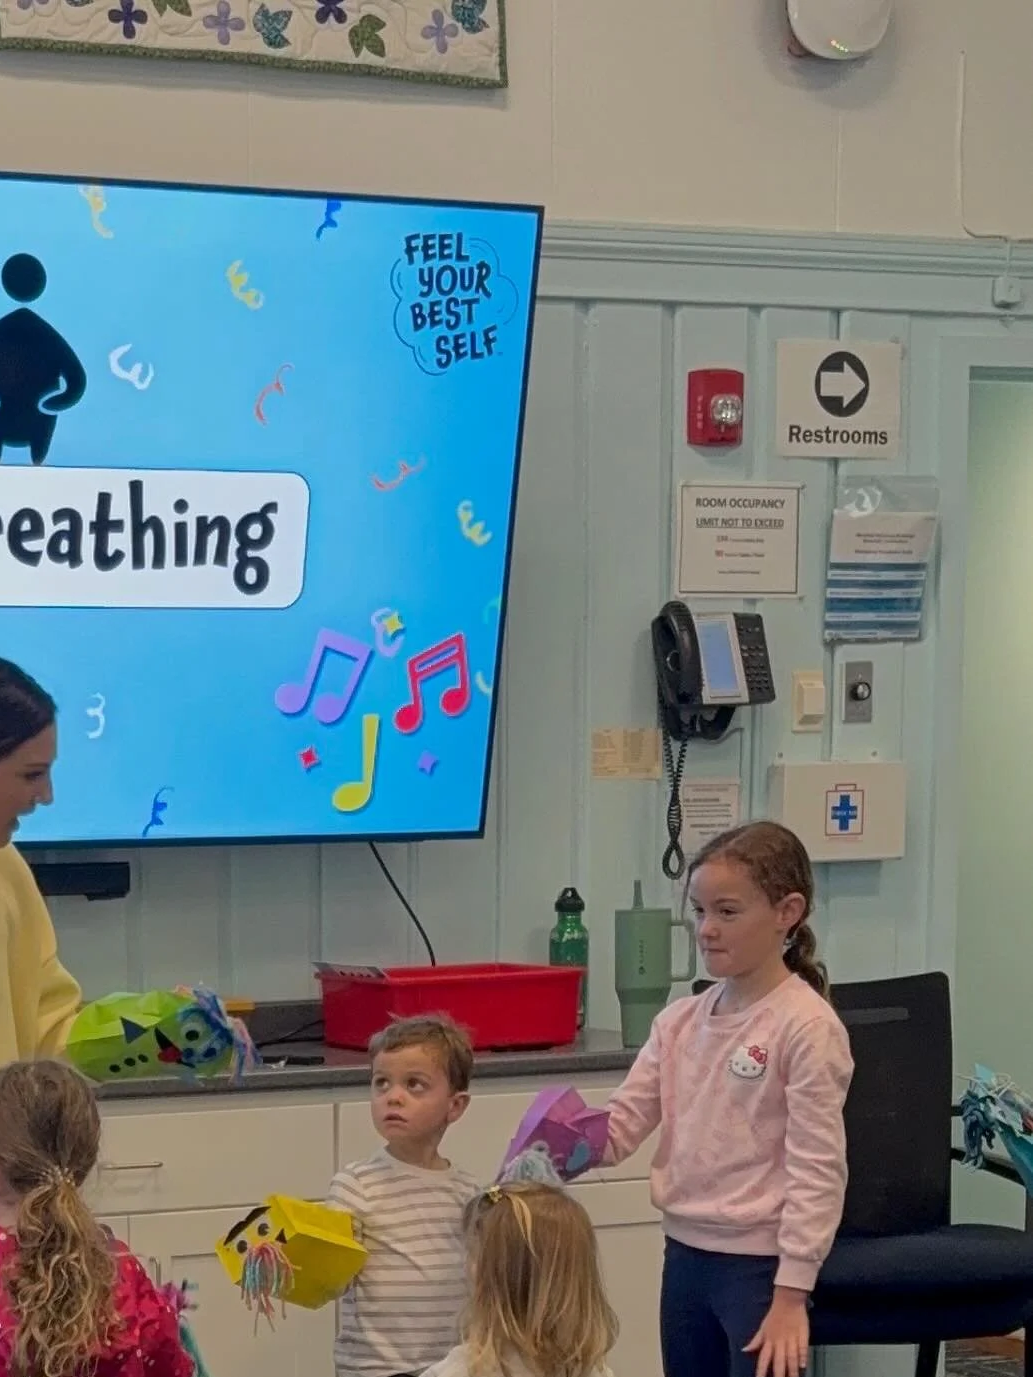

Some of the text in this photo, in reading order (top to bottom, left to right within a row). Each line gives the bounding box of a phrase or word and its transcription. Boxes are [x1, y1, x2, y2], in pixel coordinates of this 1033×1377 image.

[404, 232, 470, 265] FEEL
[418, 260, 492, 299] YOUR
[410, 297, 480, 332] BEST
[435, 325, 498, 370] SELF
[788, 424, 888, 445] Restrooms
[695, 497, 785, 509] ROOM OCCUPANCY
[695, 517, 785, 529] LIMIT NOT TO EXCEED
